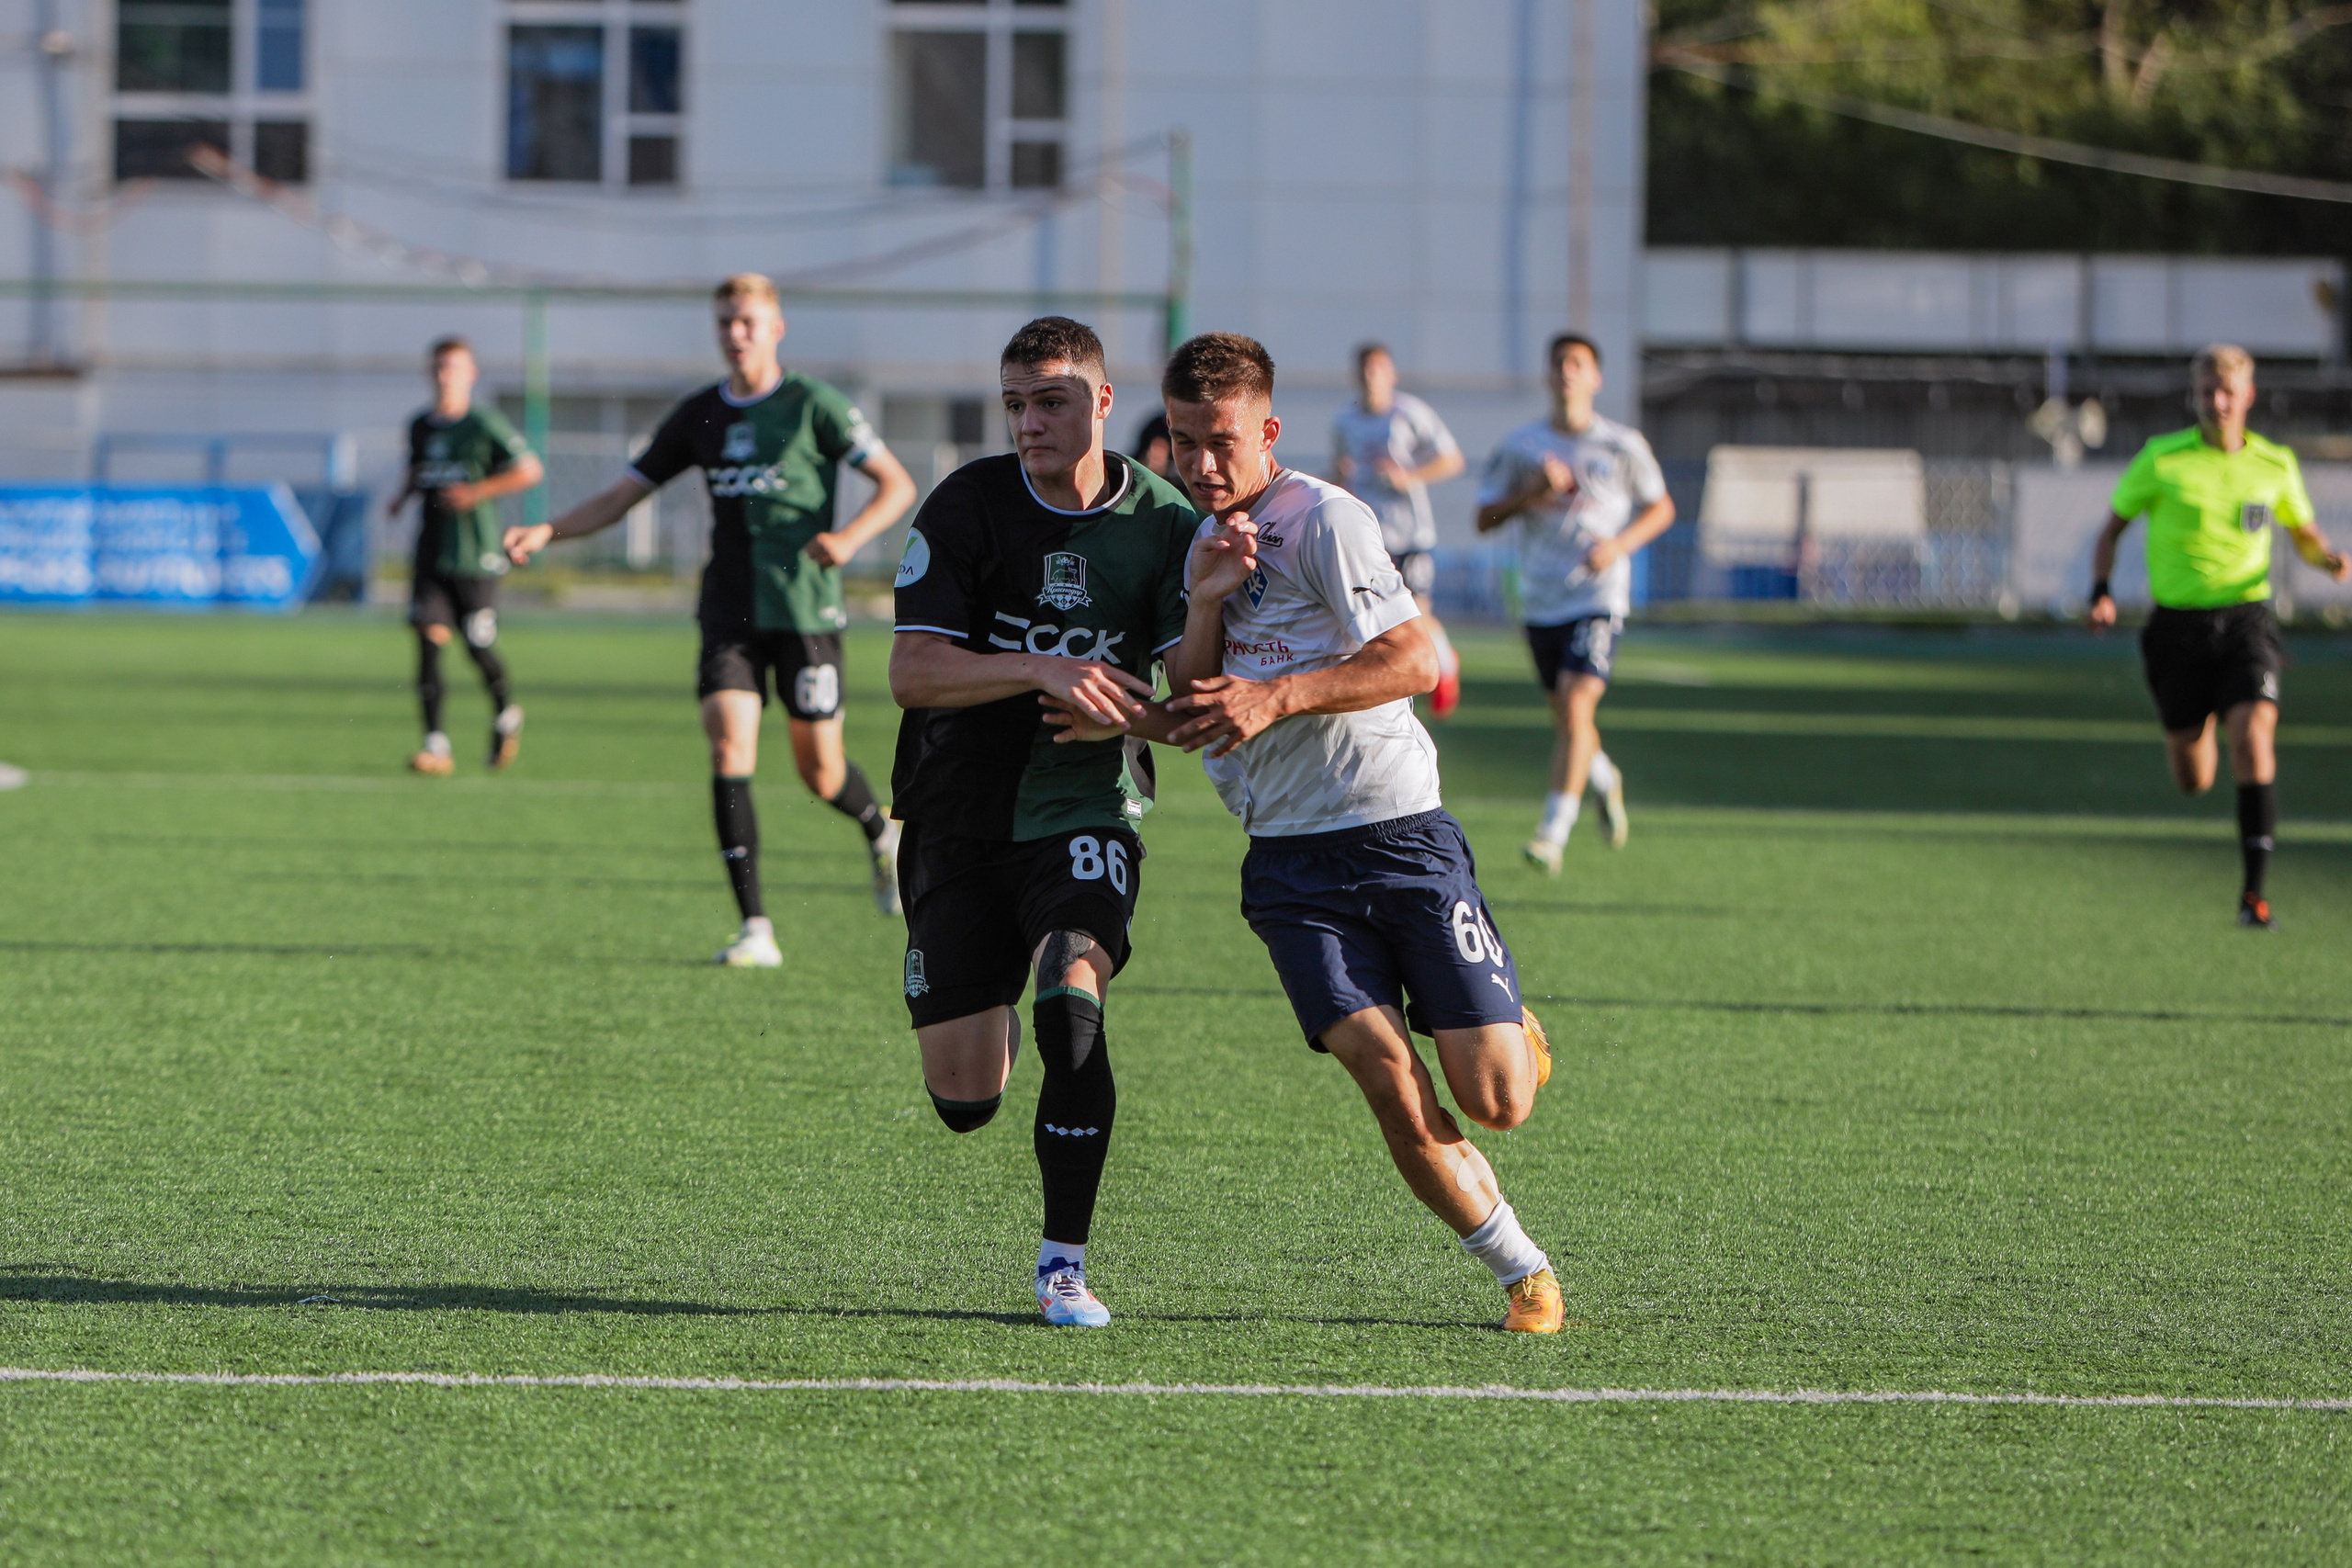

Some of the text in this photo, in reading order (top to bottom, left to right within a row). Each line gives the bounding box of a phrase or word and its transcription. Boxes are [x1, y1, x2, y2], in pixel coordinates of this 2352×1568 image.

[1225, 640, 1289, 655] РНОСТЬ
[1261, 653, 1294, 666] БАНК
[1069, 836, 1127, 896] 86
[1453, 901, 1504, 968] 60
